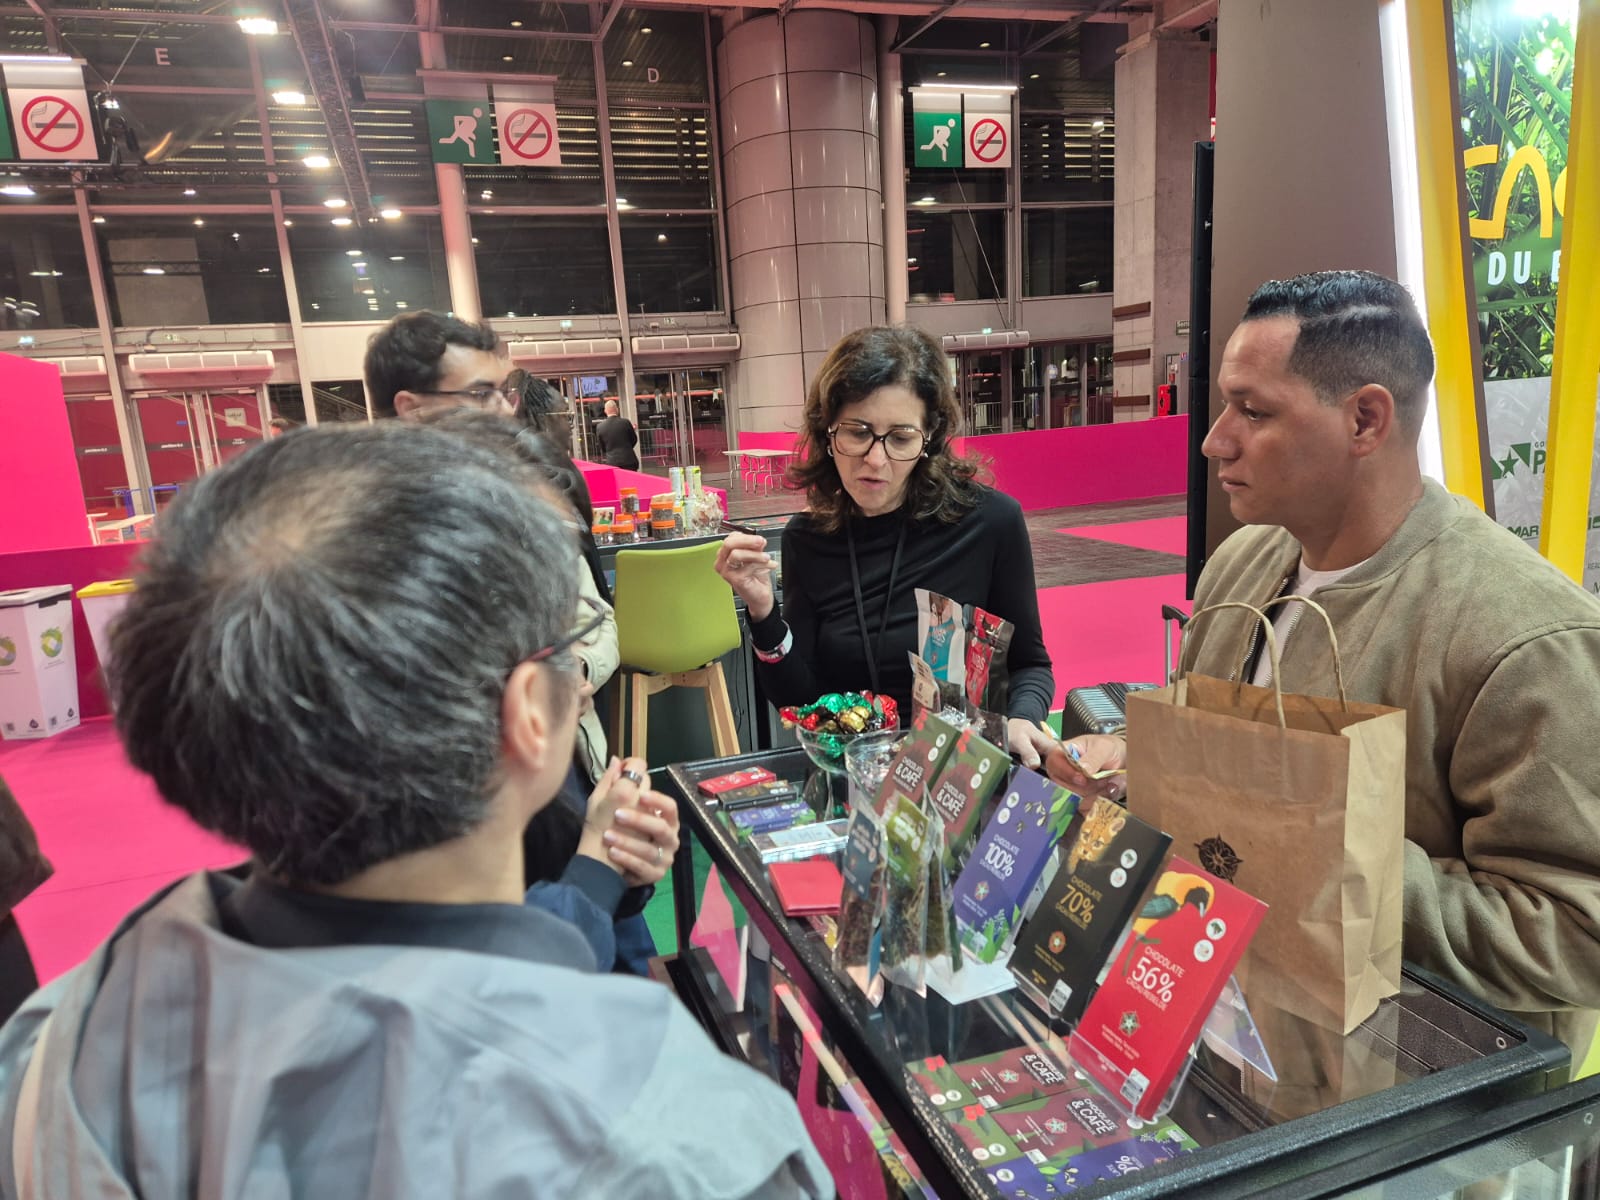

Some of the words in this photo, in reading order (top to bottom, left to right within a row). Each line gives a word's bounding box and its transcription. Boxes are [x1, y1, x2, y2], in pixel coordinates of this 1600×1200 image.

[155, 47, 171, 66] E
[647, 67, 660, 83] D
[1488, 251, 1531, 285] DU
[895, 763, 904, 776] &
[936, 789, 945, 802] &
[993, 833, 1020, 857] CHOCOLATE
[984, 842, 1016, 878] 100%
[1071, 874, 1103, 902] CHOCOLATE
[1060, 883, 1095, 924] 70%
[1144, 945, 1185, 978] CHOCOLATE
[1132, 956, 1175, 1003] 56%
[1025, 1054, 1037, 1062] &
[1071, 1100, 1085, 1109] &
[1084, 1098, 1119, 1132] CHOCOLATE
